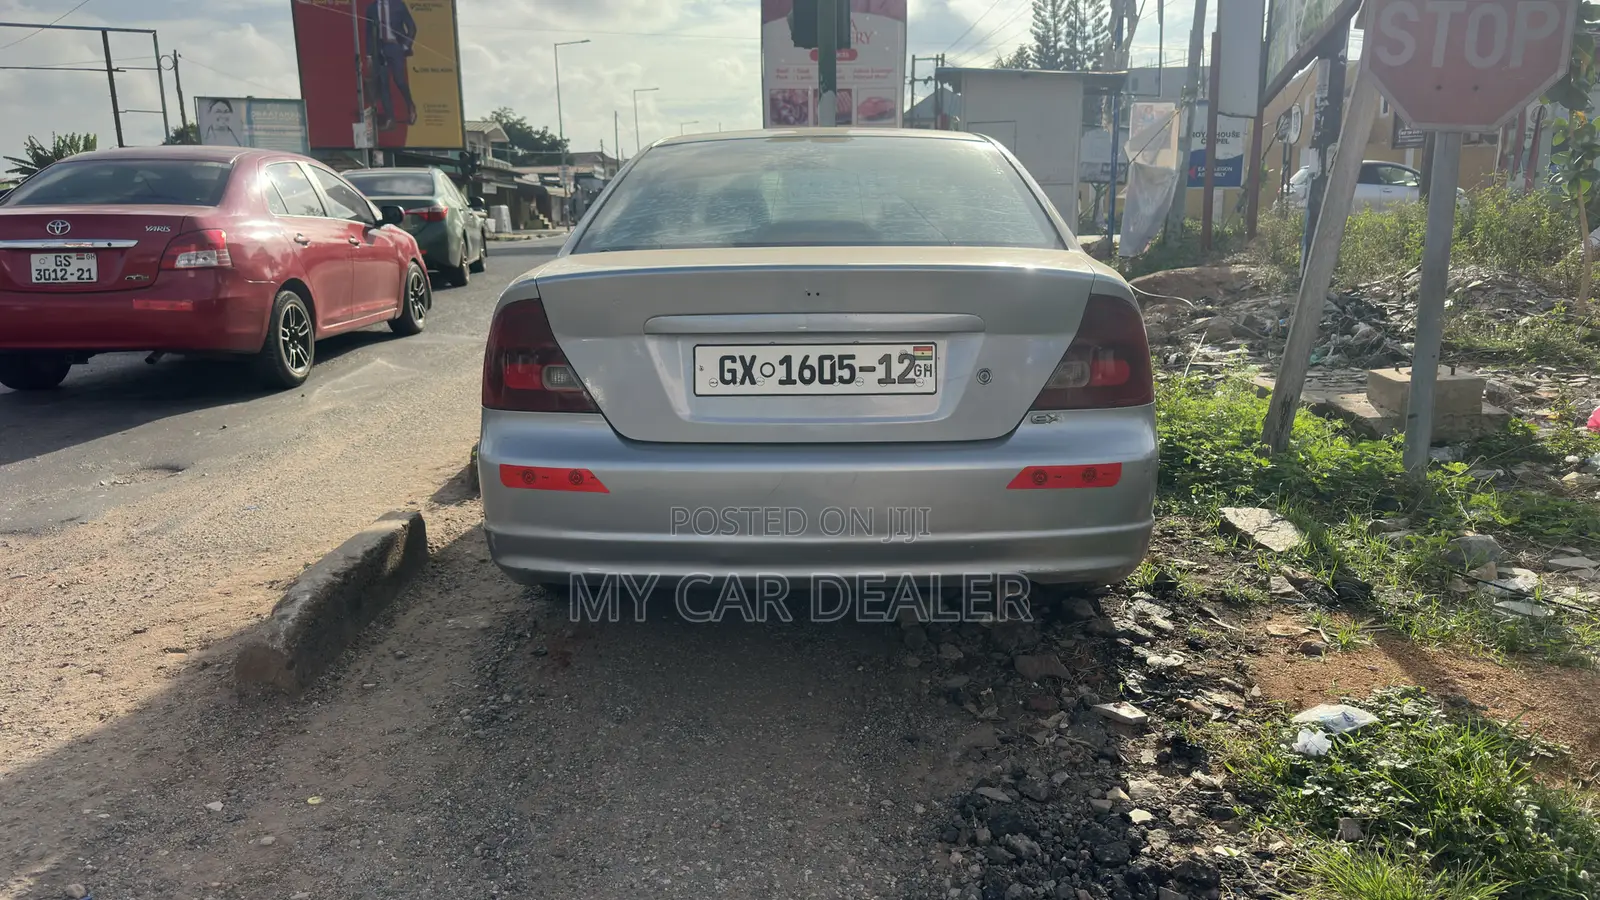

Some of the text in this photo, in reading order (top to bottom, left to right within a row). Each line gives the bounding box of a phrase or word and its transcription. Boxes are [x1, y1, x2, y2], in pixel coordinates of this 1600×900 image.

[1376, 0, 1560, 68] STOP
[145, 225, 171, 233] YARIS
[54, 255, 73, 267] GS
[35, 268, 94, 281] 3012-21
[778, 353, 916, 386] 1605-12
